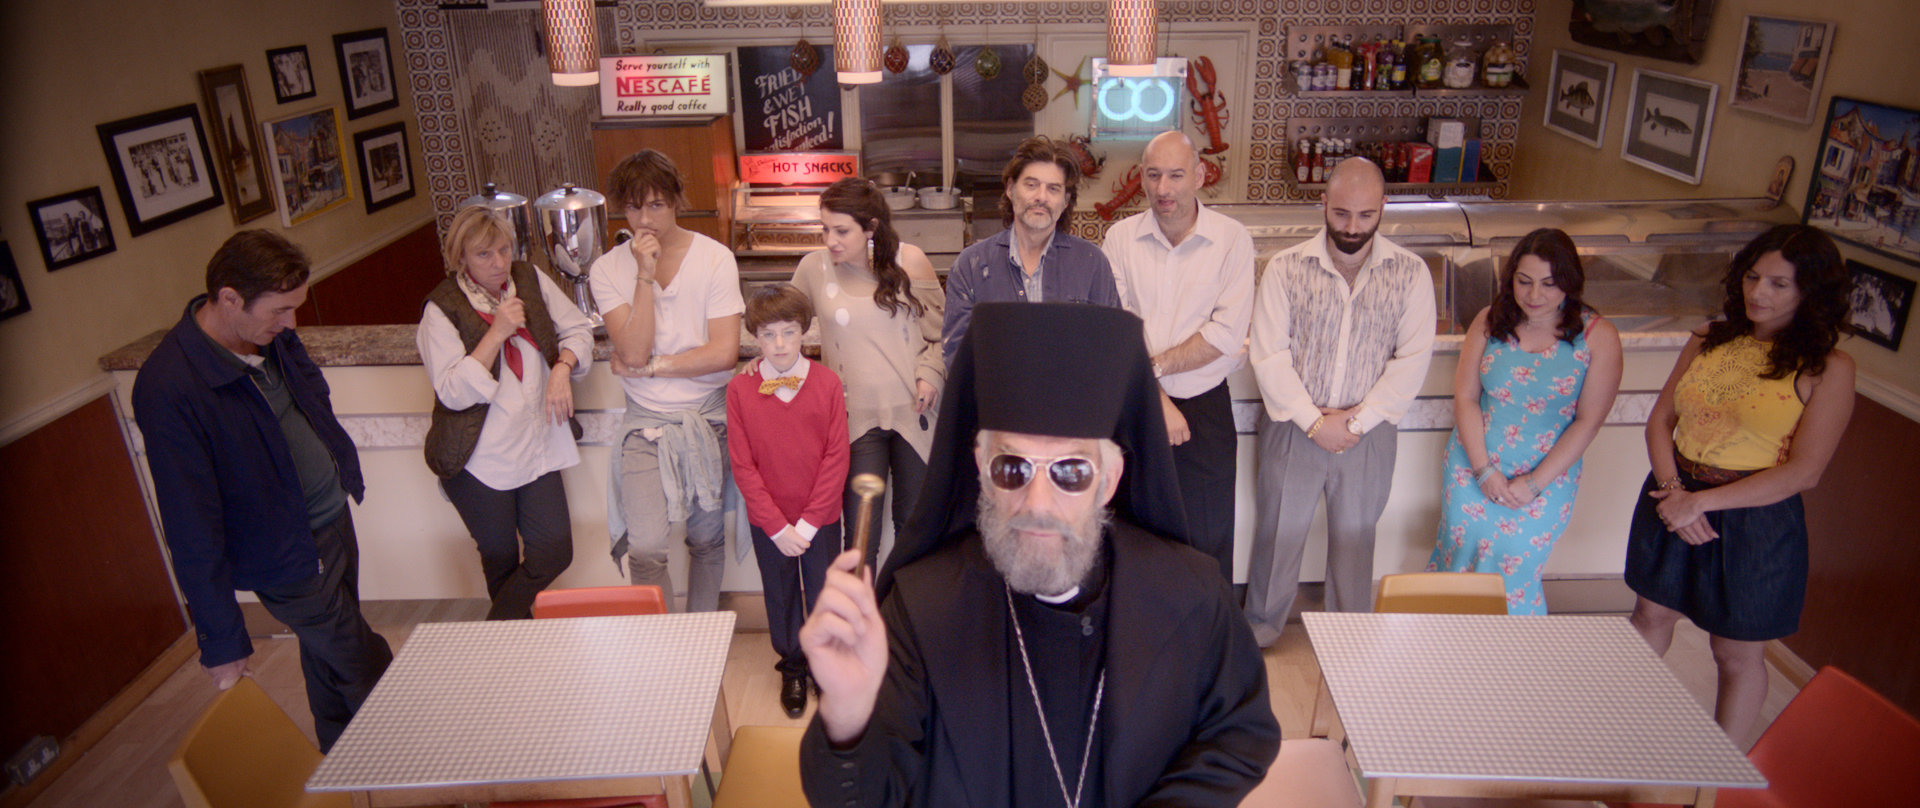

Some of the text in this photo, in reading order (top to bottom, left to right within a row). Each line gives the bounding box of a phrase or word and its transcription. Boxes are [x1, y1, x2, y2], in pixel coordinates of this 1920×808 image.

[616, 57, 711, 72] Serve yourself with
[616, 75, 711, 97] NESCAFÉ
[617, 98, 707, 114] Really good coffee
[763, 95, 812, 138] FISH
[772, 162, 799, 173] HOT
[803, 162, 853, 175] SNACKS
